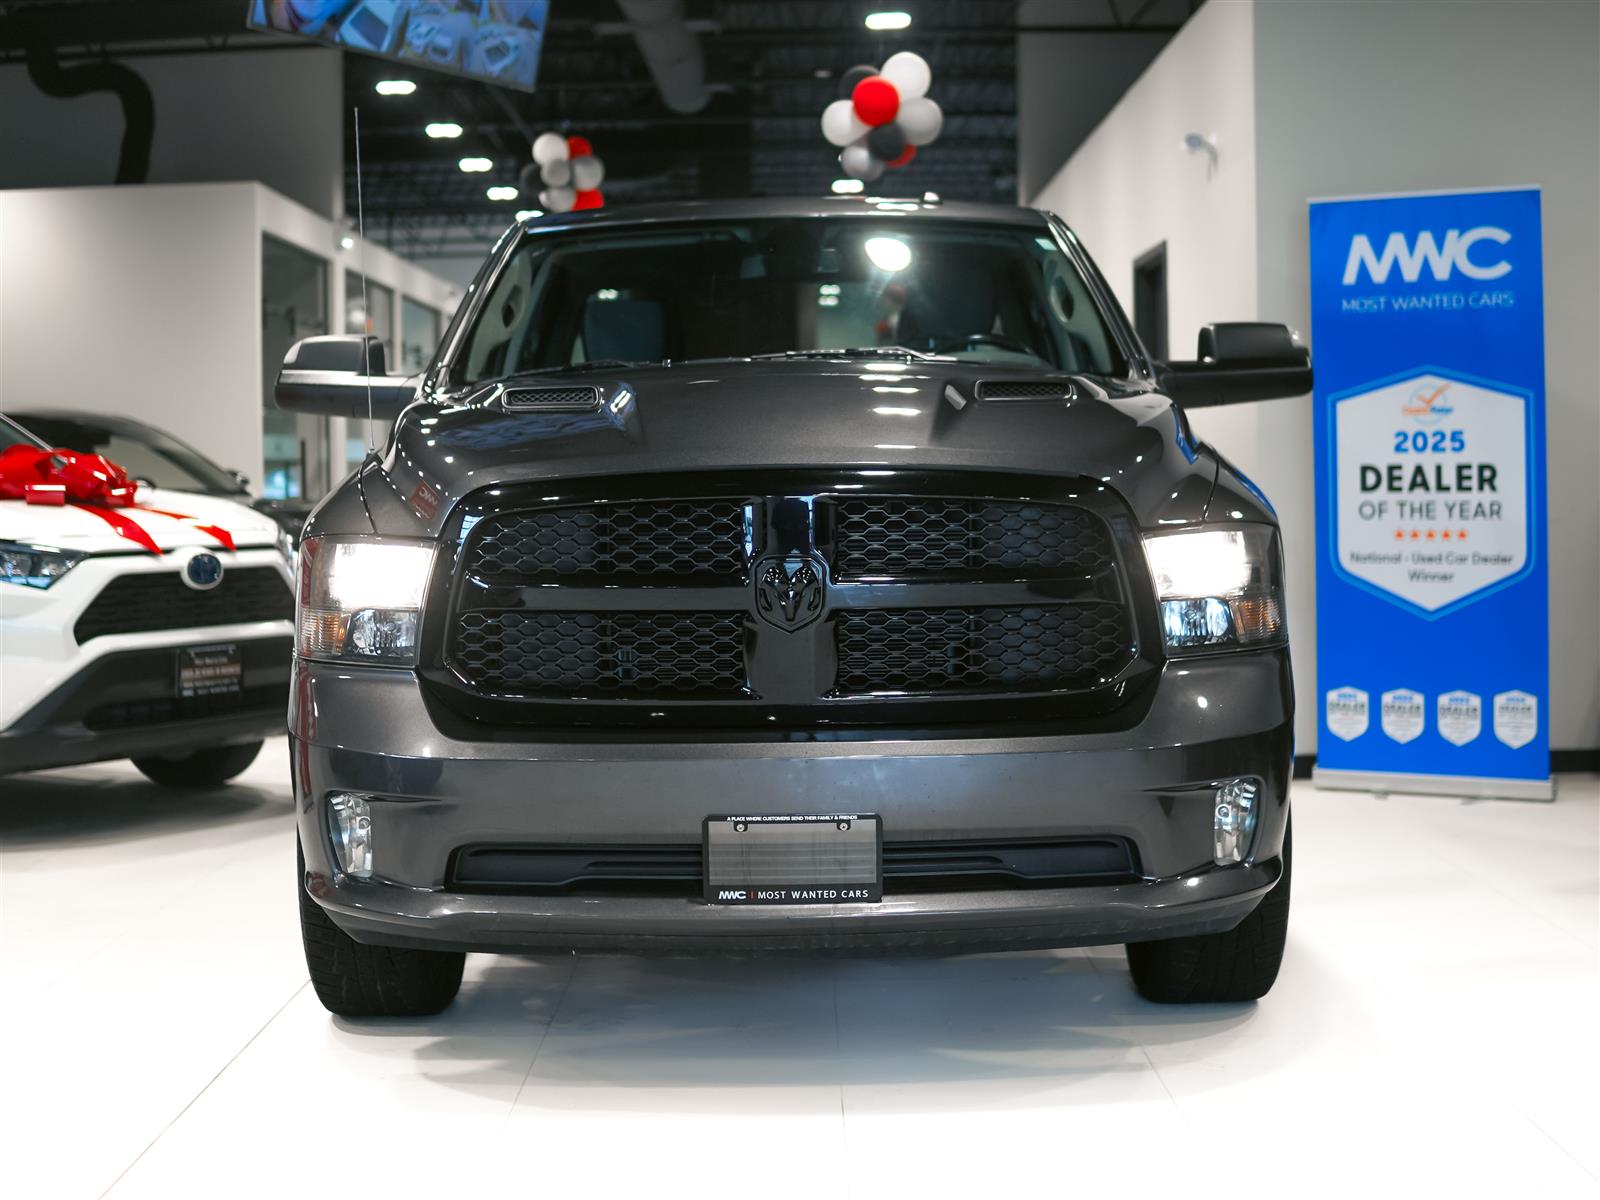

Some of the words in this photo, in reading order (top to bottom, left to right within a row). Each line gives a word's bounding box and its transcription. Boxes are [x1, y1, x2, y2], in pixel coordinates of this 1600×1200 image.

[1342, 226, 1512, 285] MWC
[1342, 296, 1386, 313] MOST
[1392, 293, 1464, 311] WANTED
[1469, 291, 1514, 308] CARS
[1394, 430, 1465, 453] 2025
[1360, 464, 1498, 493] DEALER
[1358, 501, 1388, 521] OF
[1397, 501, 1437, 520] THE
[1445, 501, 1503, 520] YEAR
[1350, 551, 1401, 564] National
[1412, 552, 1442, 565] Used
[1446, 552, 1468, 565] Car
[1472, 552, 1513, 566] Dealer
[1408, 569, 1454, 582] Winner
[719, 891, 746, 899] MWC
[758, 891, 786, 900] MOST
[791, 890, 837, 899] WANTED
[841, 890, 869, 898] CARS
